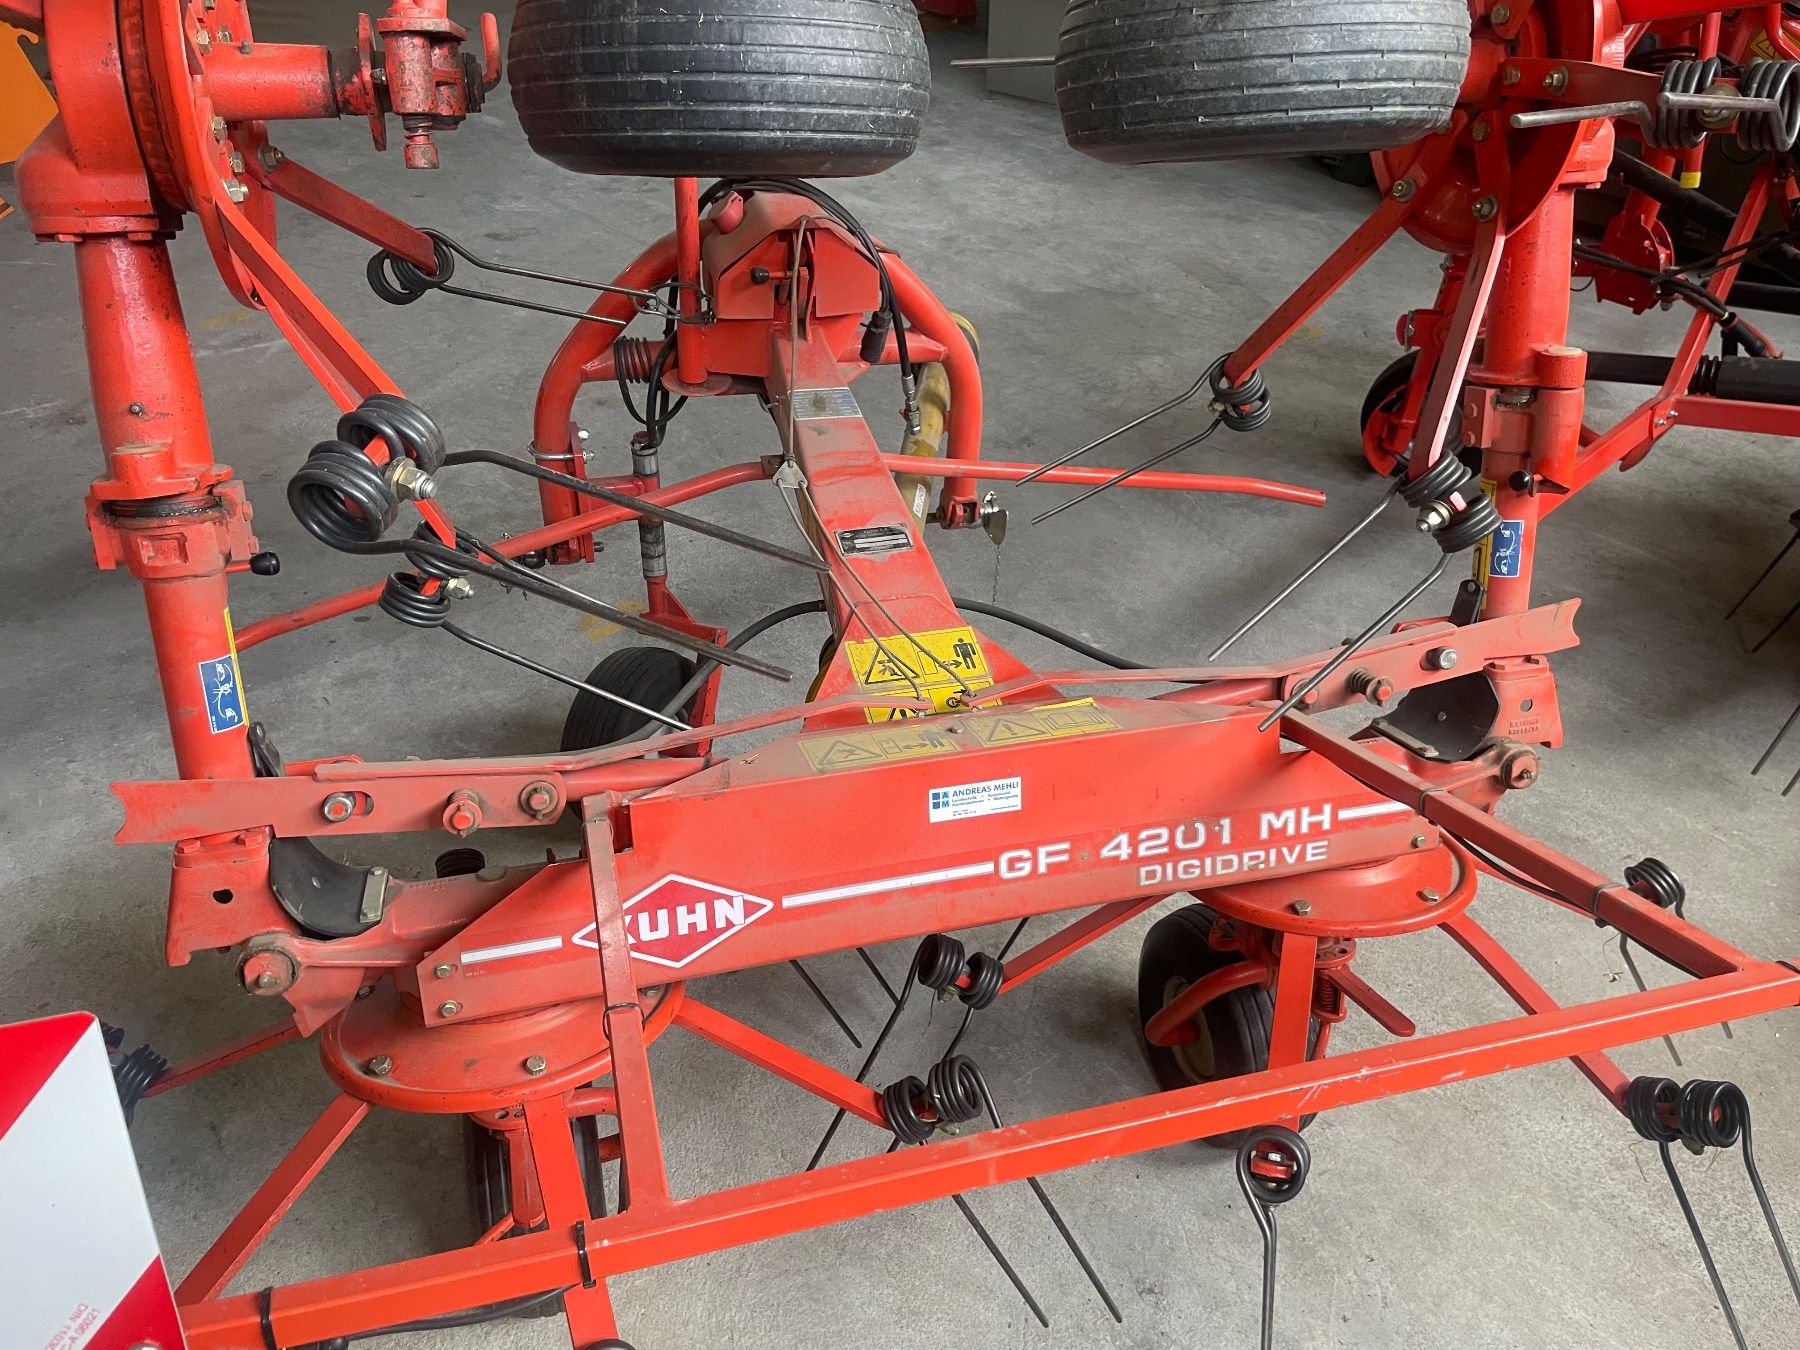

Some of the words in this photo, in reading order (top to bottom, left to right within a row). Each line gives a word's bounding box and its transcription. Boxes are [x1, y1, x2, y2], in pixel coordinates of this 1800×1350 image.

[952, 786, 992, 797] ANDREAS
[994, 781, 1019, 791] MEHLI
[998, 841, 1071, 880] GF
[1100, 816, 1233, 862] 4201
[1259, 803, 1333, 841] MH
[1138, 840, 1330, 887] DIGIDRIVE
